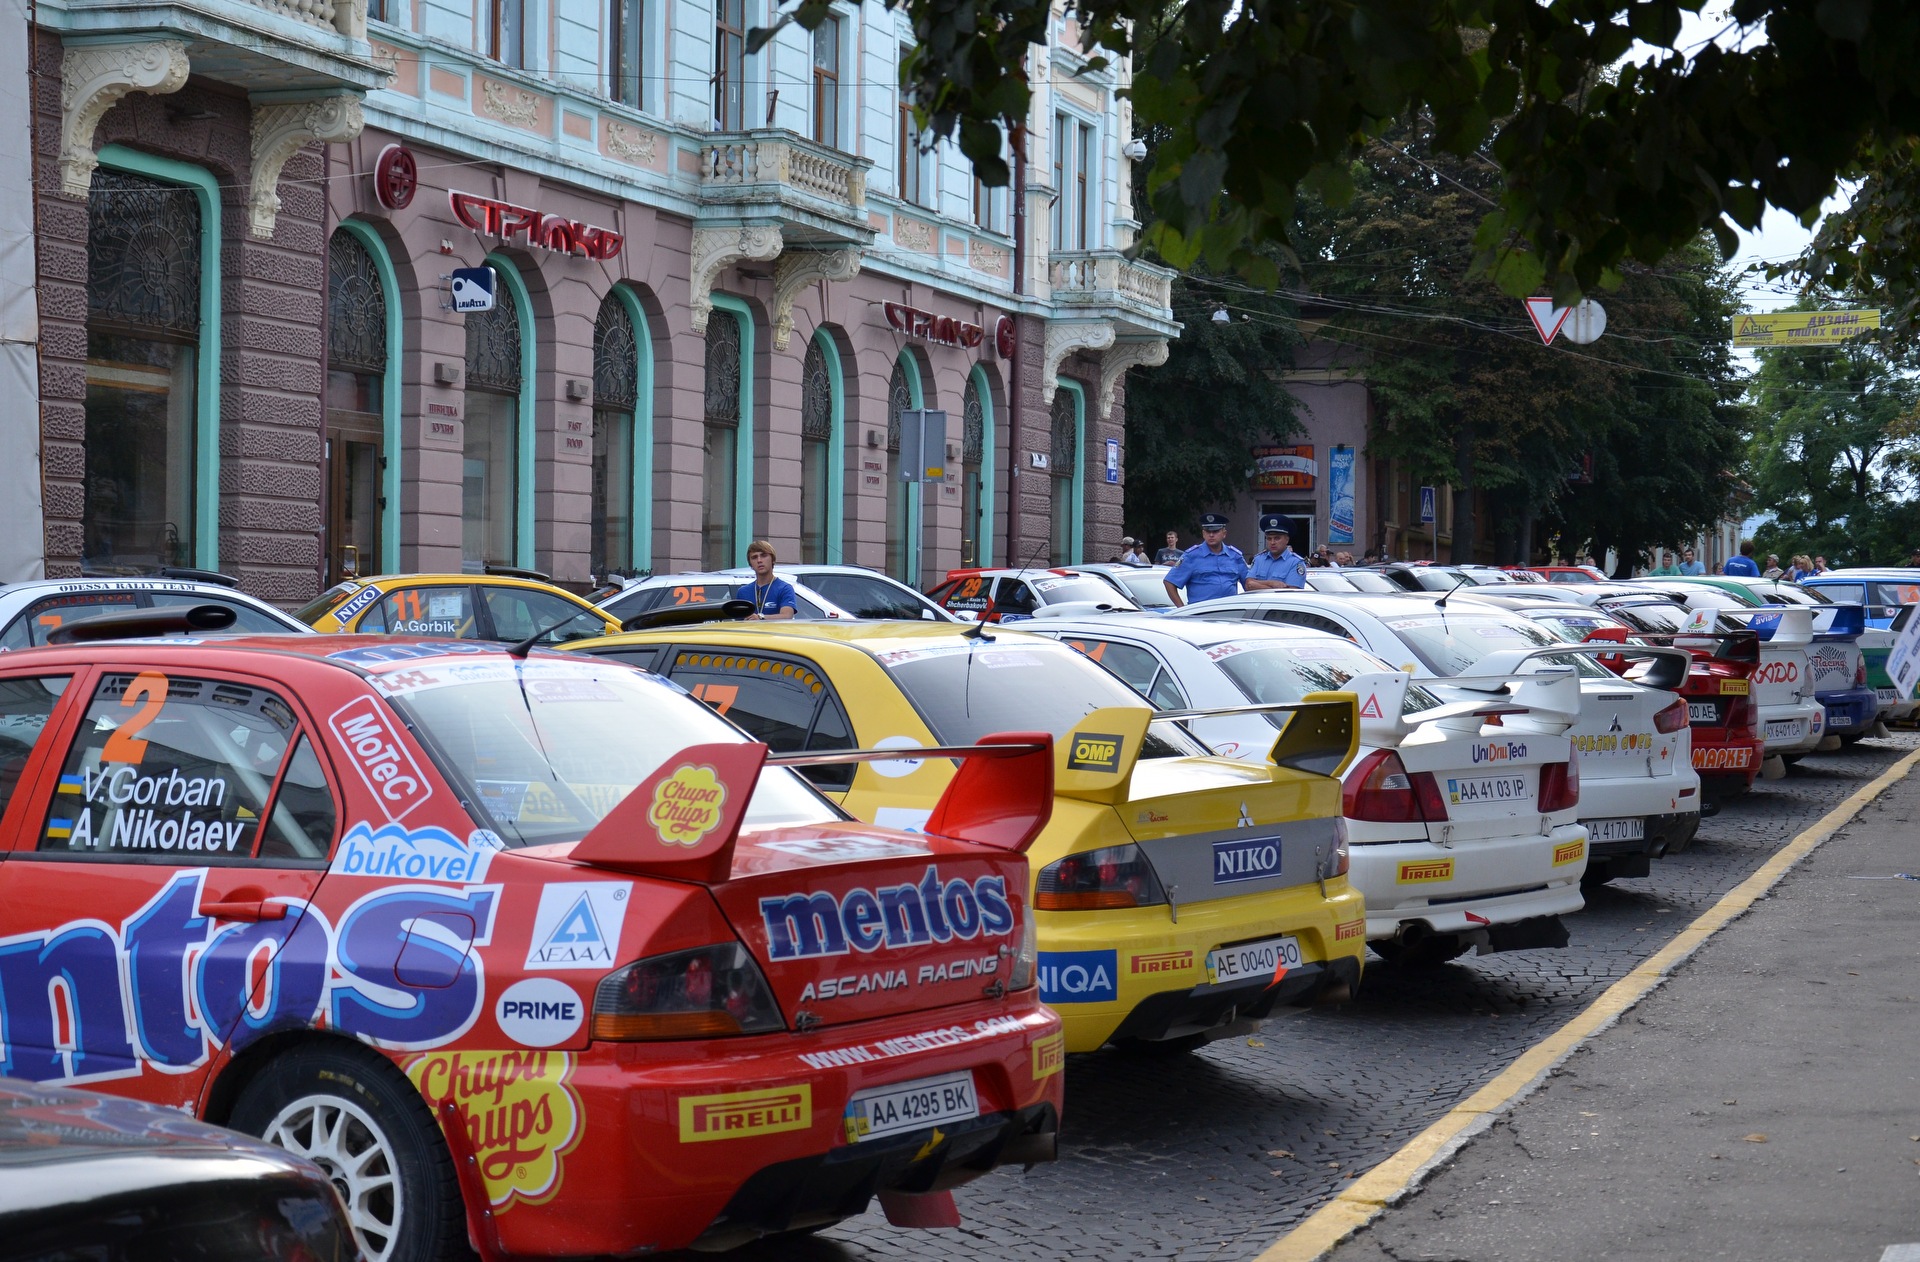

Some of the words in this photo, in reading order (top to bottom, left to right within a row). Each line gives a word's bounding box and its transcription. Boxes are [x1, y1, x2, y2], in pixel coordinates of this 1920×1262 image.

[458, 298, 486, 308] LAVAZZA
[1807, 312, 1859, 328] ДИЗАЙН
[1787, 328, 1826, 337] ВАШИХ
[429, 403, 458, 417] ШВИДКА
[431, 422, 454, 435] КУХНЯ
[567, 420, 582, 431] FAST
[566, 438, 583, 449] FOOD
[59, 583, 110, 592] ODESSA
[115, 582, 155, 591] RALLY
[160, 582, 196, 591] TEAM
[673, 586, 707, 605] 25
[961, 578, 983, 598] 29
[337, 587, 376, 621] NIKO
[392, 590, 422, 621] 11
[393, 620, 456, 633] A.Gorbik
[1813, 656, 1846, 668] Racing
[1723, 682, 1747, 692] PIRELLI
[100, 670, 169, 764] 2
[1702, 704, 1714, 719] AE
[341, 712, 418, 801] MoTeC
[1076, 743, 1115, 762] OMP
[84, 766, 226, 807] V.Gorban
[663, 780, 719, 806] Chupa
[1461, 783, 1479, 800] AA
[654, 800, 712, 834] Chups
[69, 807, 100, 846] A.
[110, 807, 245, 851] Nikolaev
[1603, 821, 1628, 839] 4170
[1631, 820, 1643, 837] IM
[342, 841, 480, 882] bukovel
[1217, 844, 1278, 876] NIKO
[1555, 843, 1583, 863] PIRELLI
[1401, 863, 1450, 880] PIRELLI
[758, 864, 1014, 962] mentos
[1131, 950, 1193, 973] PIRELLI
[1218, 954, 1239, 977] AE
[1240, 948, 1274, 972] 0040
[1276, 943, 1298, 965] BO
[800, 969, 908, 1002] ASCANIA
[918, 955, 998, 985] RACING
[502, 1001, 576, 1021] PRIME
[420, 1050, 548, 1106] Chupa
[693, 1094, 802, 1132] PIRELLI
[873, 1100, 899, 1127] AA
[902, 1092, 940, 1119] 4295
[942, 1085, 969, 1112] BK
[859, 1122, 868, 1130] UA
[458, 1093, 553, 1180] hups
